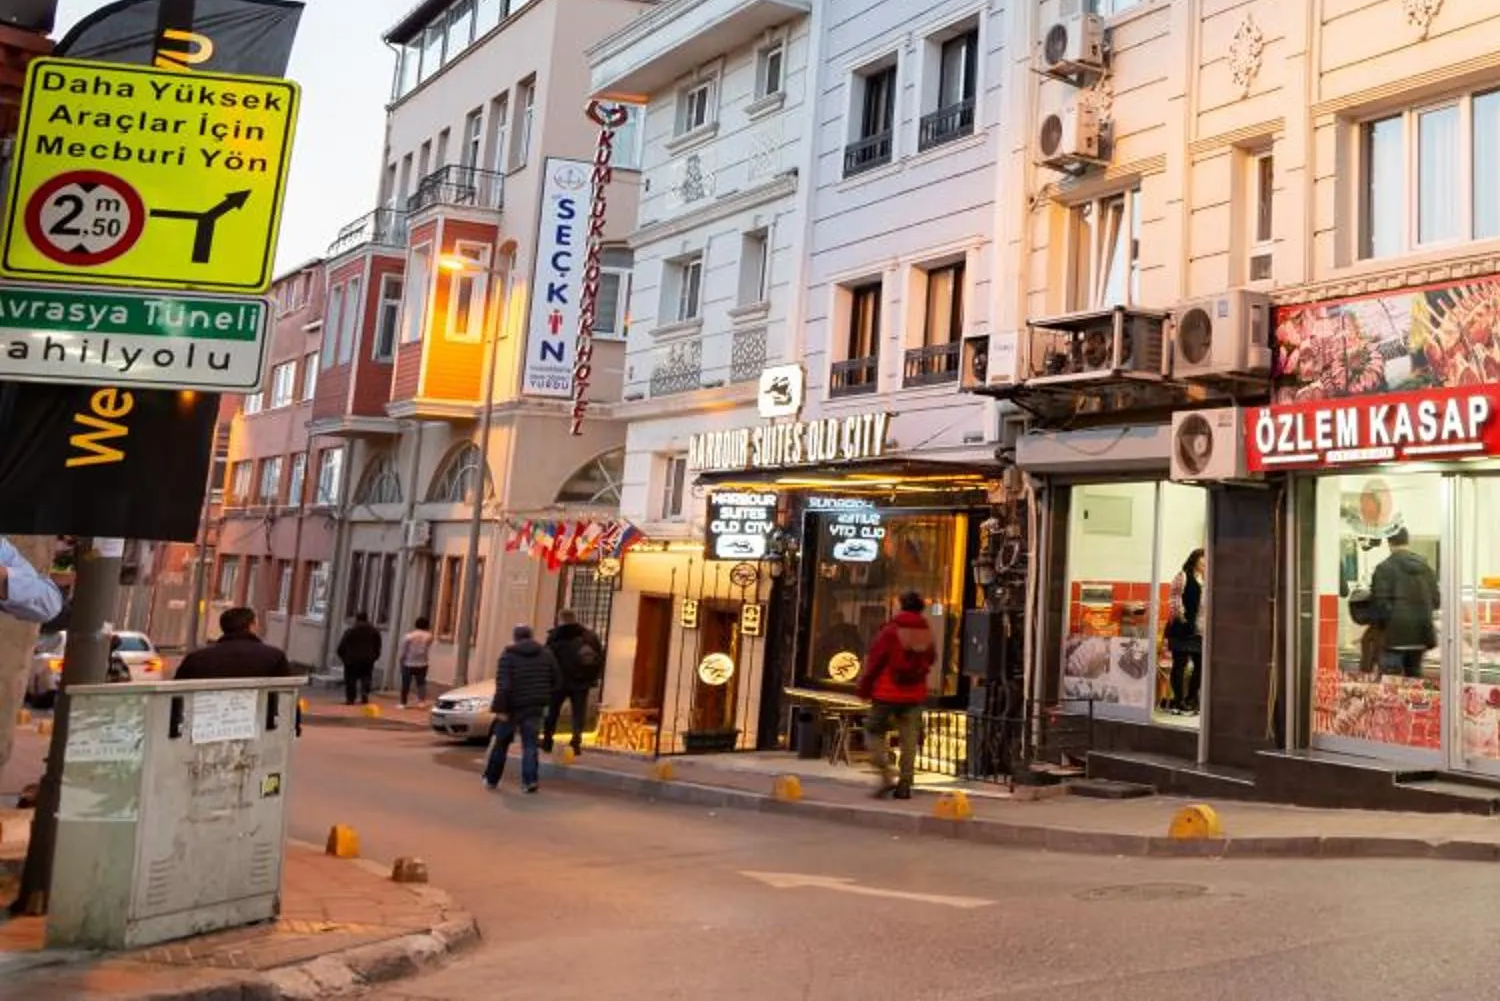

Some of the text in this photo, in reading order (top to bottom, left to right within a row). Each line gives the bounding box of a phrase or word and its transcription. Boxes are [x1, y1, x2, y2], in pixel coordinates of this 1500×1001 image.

[42, 71, 281, 112] Daha Yüksek
[48, 104, 265, 141] Araçlar İçin
[36, 134, 267, 172] Mecburi Yön
[571, 130, 615, 436] KUMLUK KONAK HOTEL
[145, 301, 257, 332] Tüneli
[689, 412, 887, 470] HARBOUR SUITES OLD CITY
[1255, 395, 1490, 454] ÖZLEM KASAP
[711, 520, 773, 533] OLD CITY
[720, 507, 766, 519] SUITES
